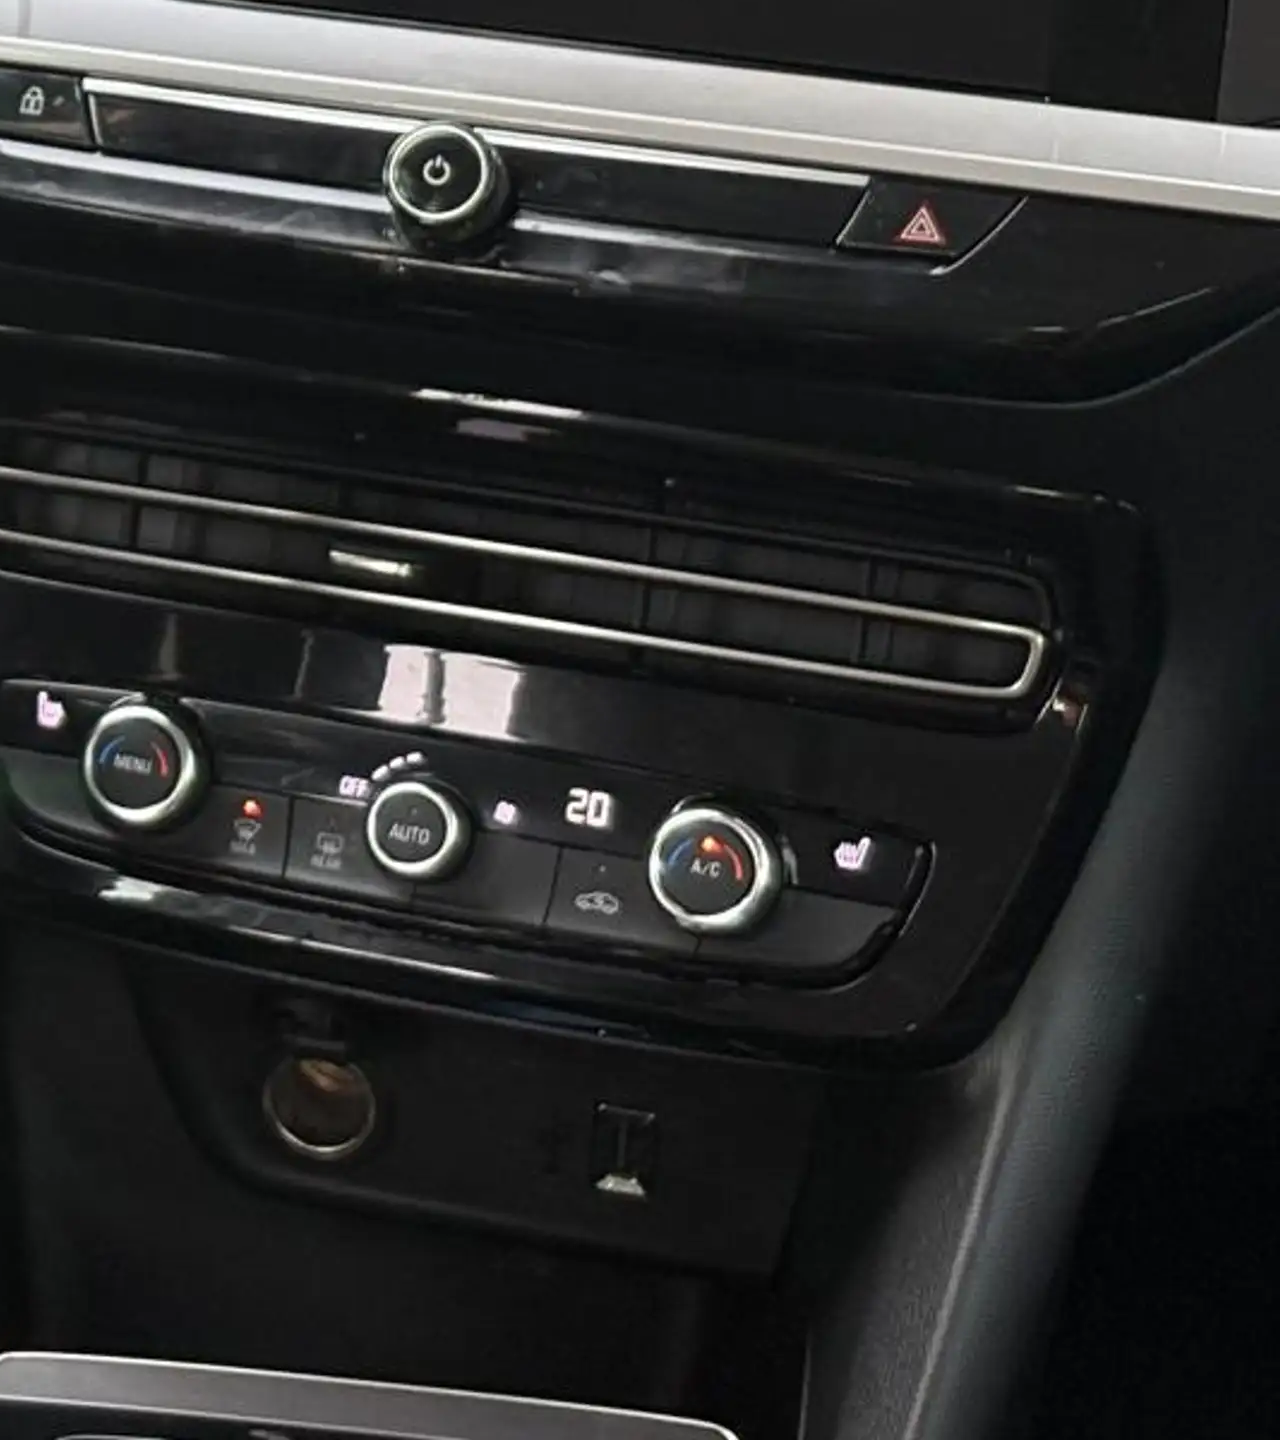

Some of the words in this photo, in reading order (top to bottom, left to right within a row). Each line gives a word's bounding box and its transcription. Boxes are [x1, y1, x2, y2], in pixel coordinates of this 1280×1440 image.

[113, 752, 153, 773] MENU
[339, 775, 371, 798] OFF
[564, 787, 614, 829] 20
[388, 823, 431, 846] AUTO
[689, 859, 722, 879] A/C
